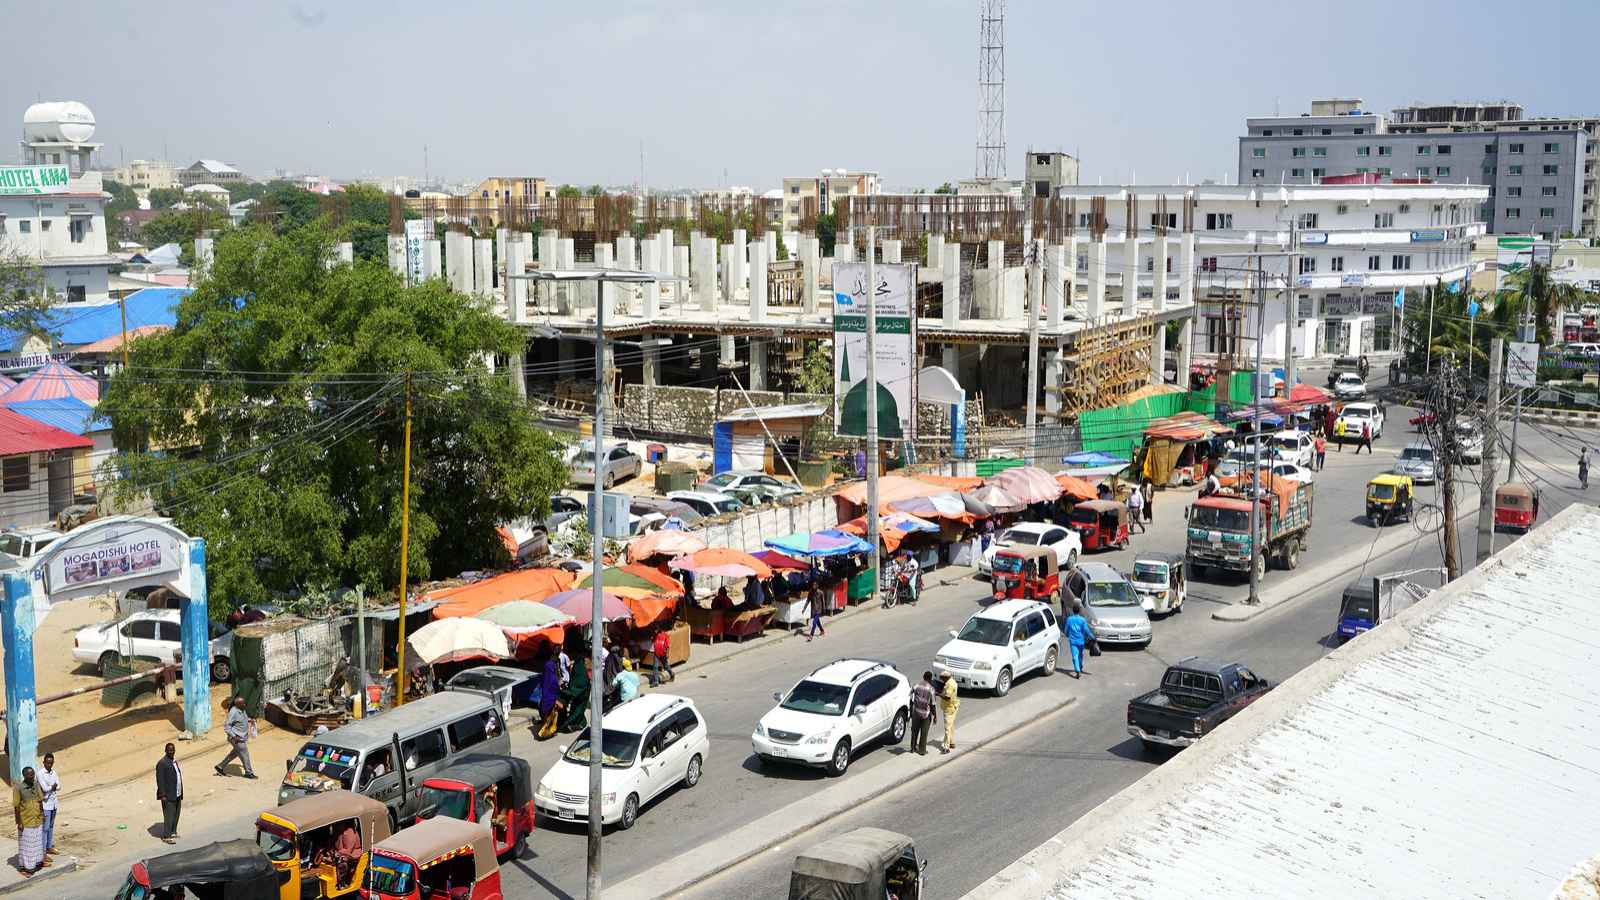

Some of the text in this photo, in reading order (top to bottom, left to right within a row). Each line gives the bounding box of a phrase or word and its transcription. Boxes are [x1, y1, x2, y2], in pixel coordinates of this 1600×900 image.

[40, 168, 68, 187] KM4
[21, 353, 44, 367] HOTEL
[64, 539, 161, 567] MOGADISHU HOTEL
